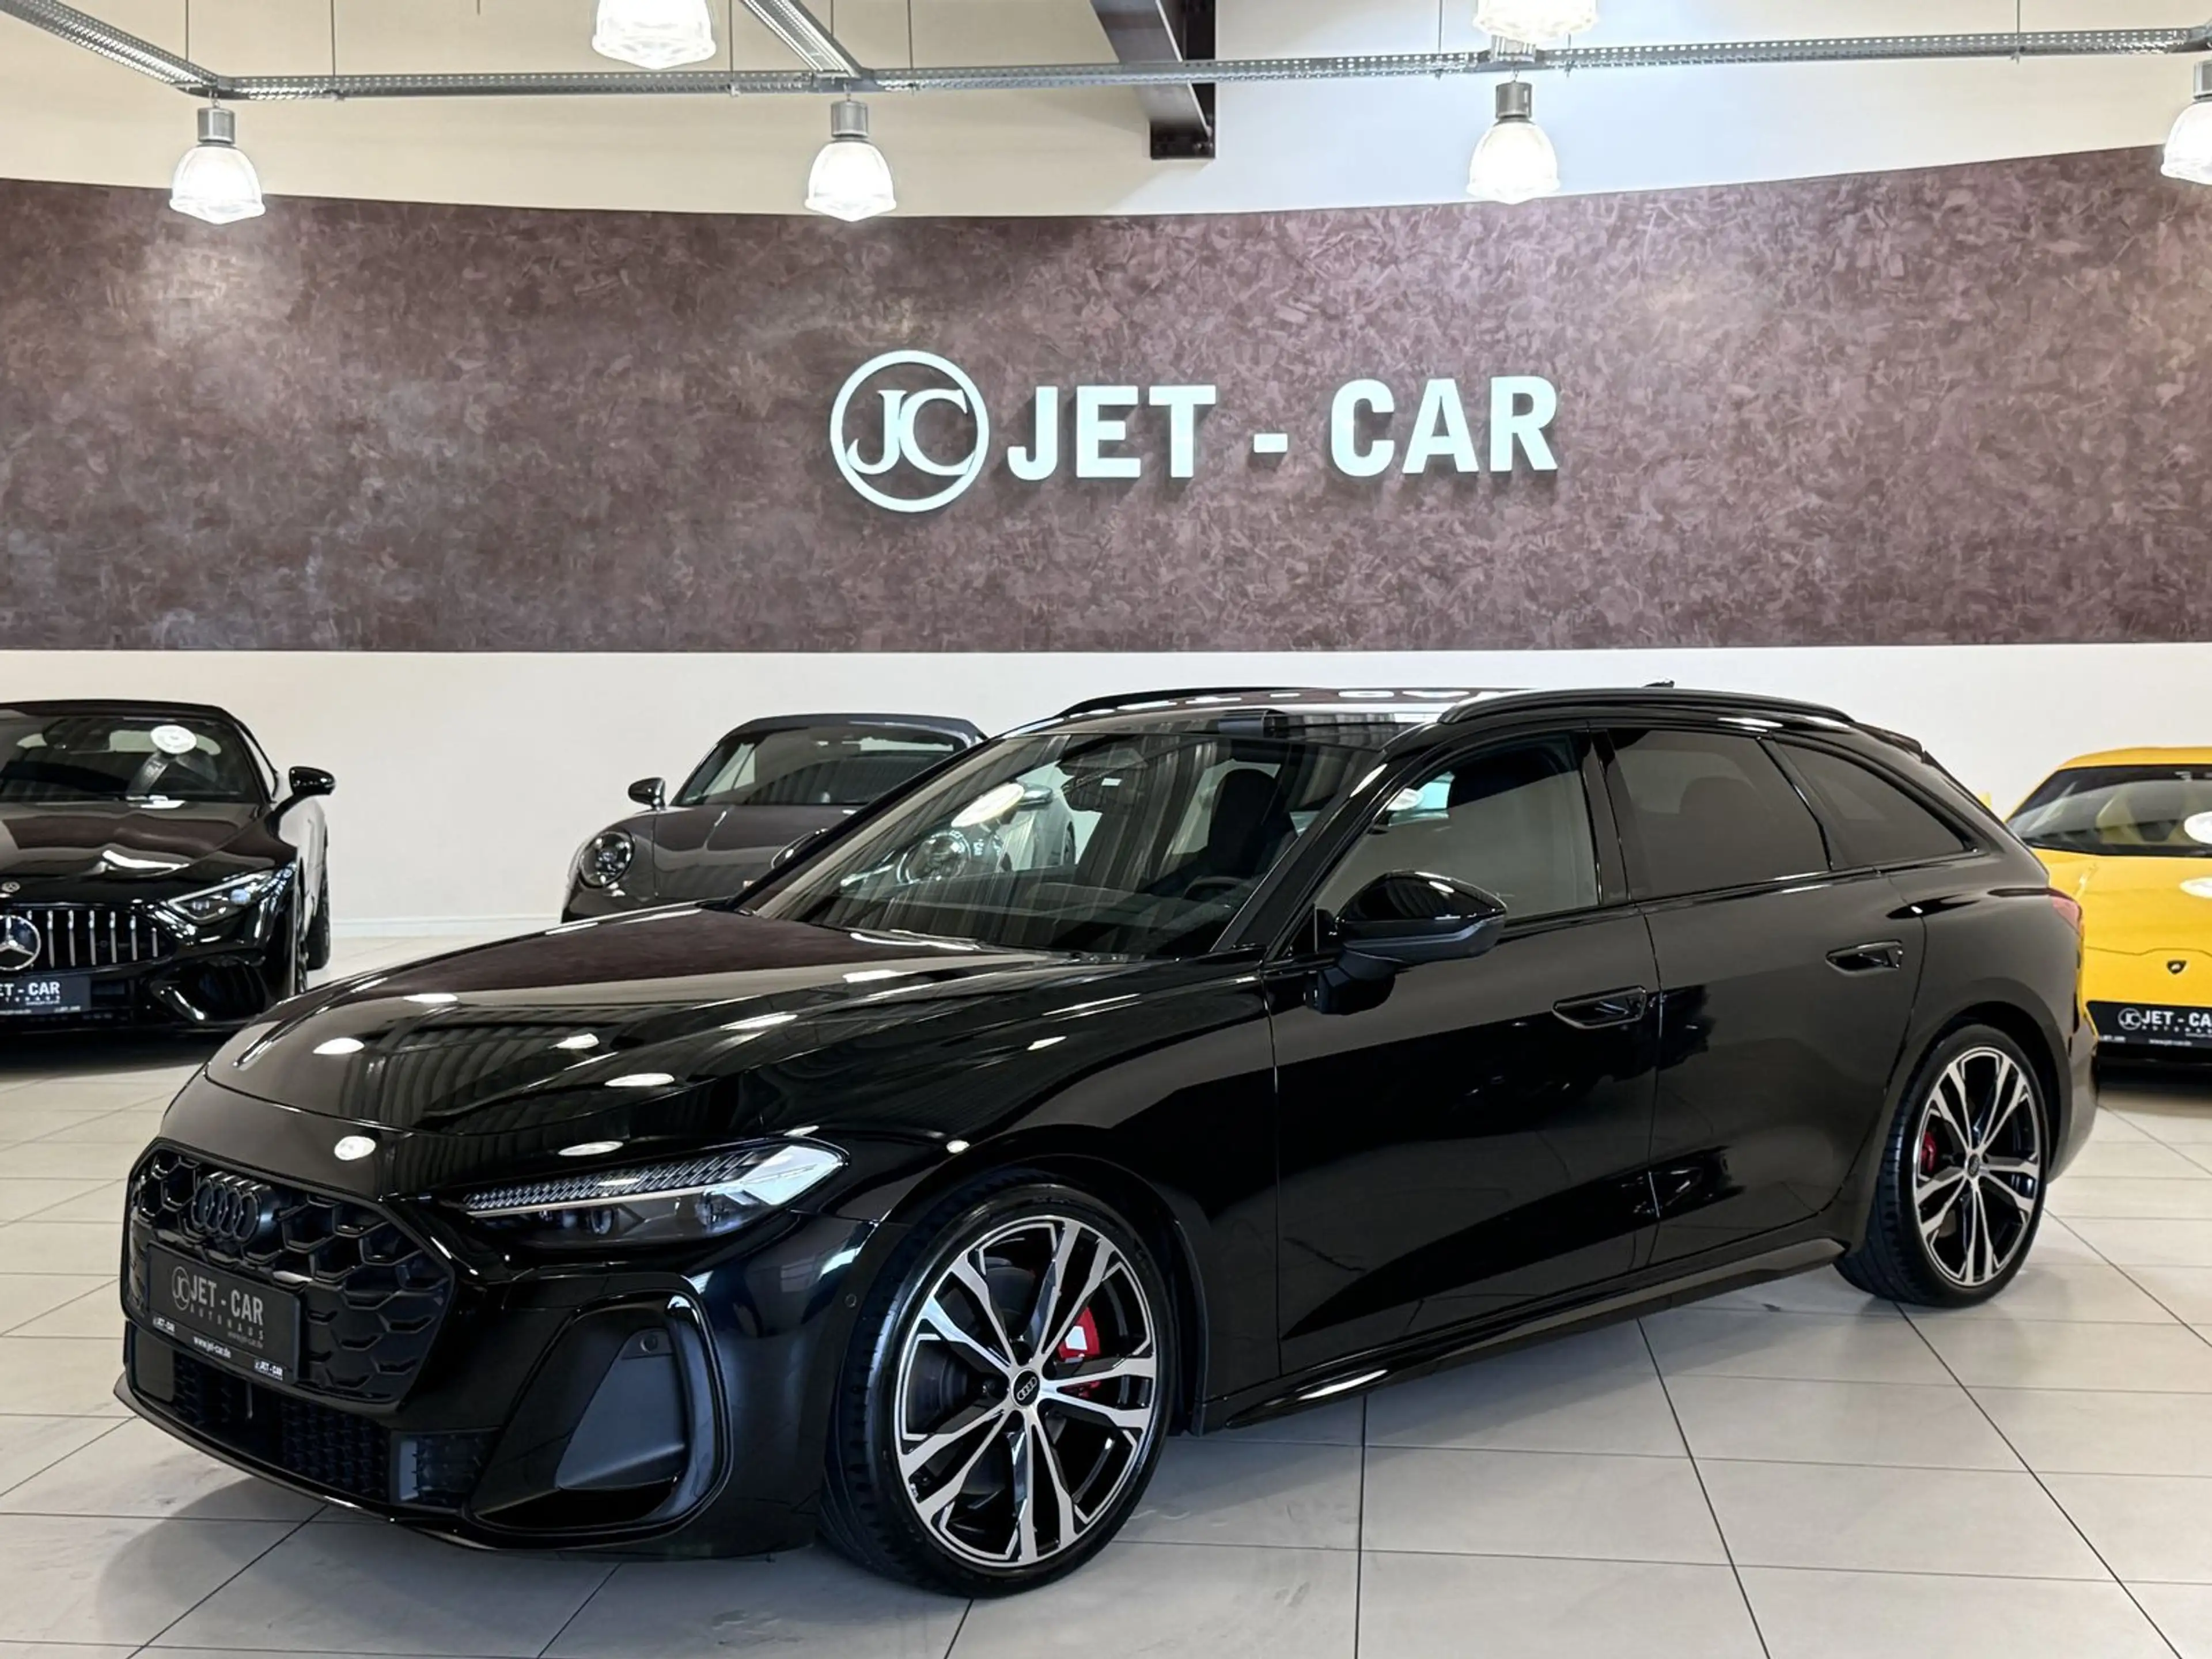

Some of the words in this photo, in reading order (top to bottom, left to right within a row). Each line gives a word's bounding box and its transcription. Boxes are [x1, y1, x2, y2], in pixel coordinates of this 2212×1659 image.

[1007, 385, 1215, 480] JET
[1331, 376, 1558, 476] CAR
[28, 982, 60, 995] CAR
[2141, 1010, 2174, 1025] JET
[190, 1274, 217, 1308] JET
[231, 1289, 264, 1325] CAR
